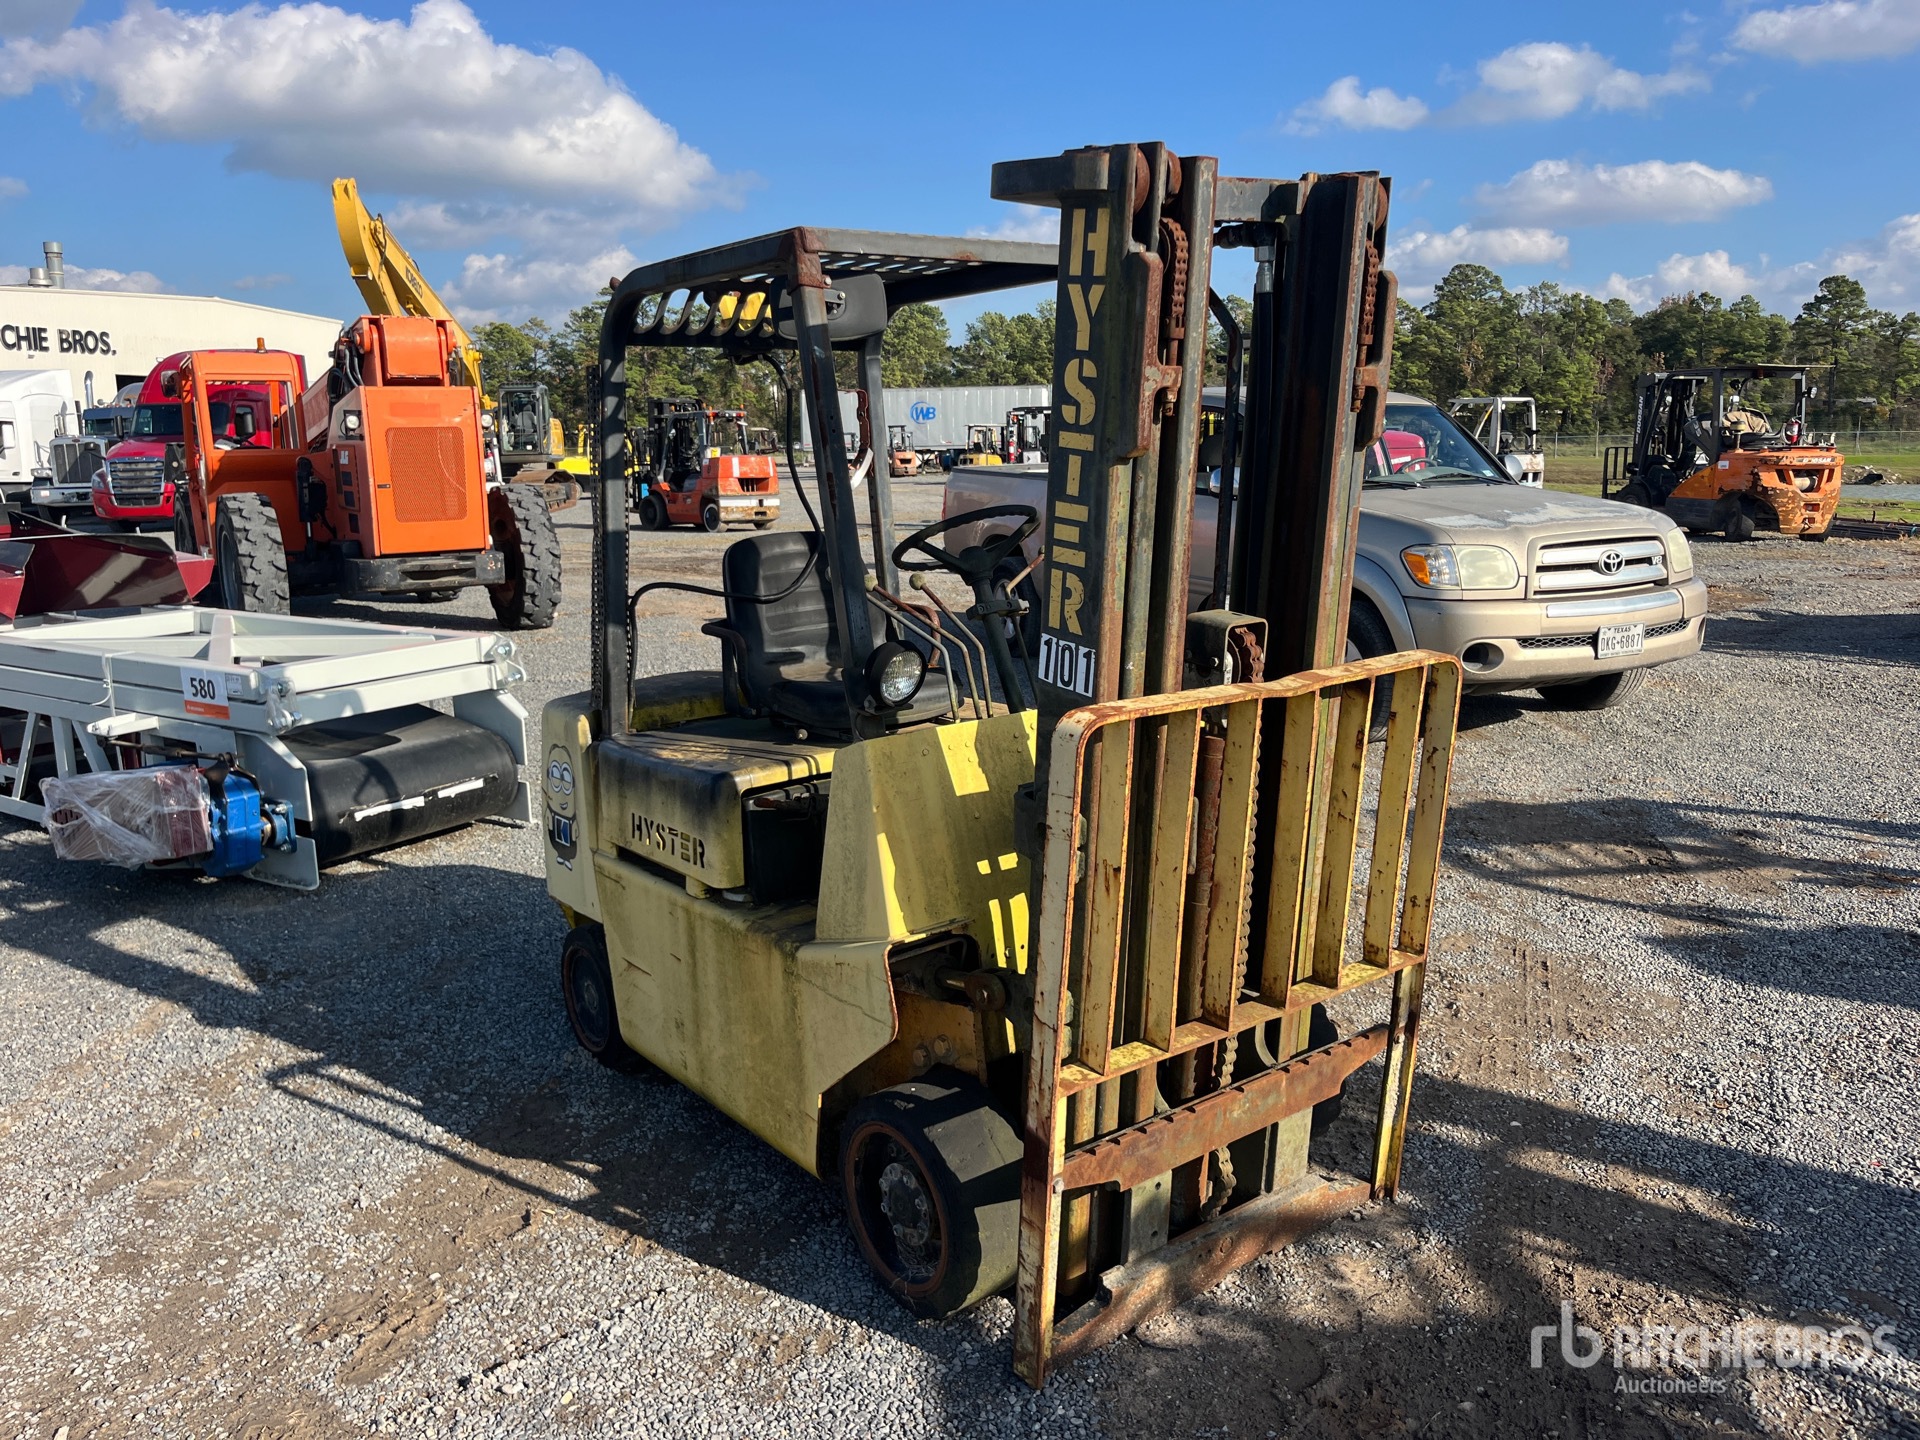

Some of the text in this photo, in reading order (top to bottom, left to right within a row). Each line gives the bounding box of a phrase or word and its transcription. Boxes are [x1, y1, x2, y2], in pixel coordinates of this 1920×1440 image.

[57, 328, 117, 356] BROS.
[1048, 208, 1110, 636] HYSTER
[1652, 555, 1663, 565] V8
[1614, 626, 1631, 634] TEXAS
[1043, 638, 1094, 694] 101
[190, 677, 216, 700] 580
[632, 813, 705, 868] HYSTER
